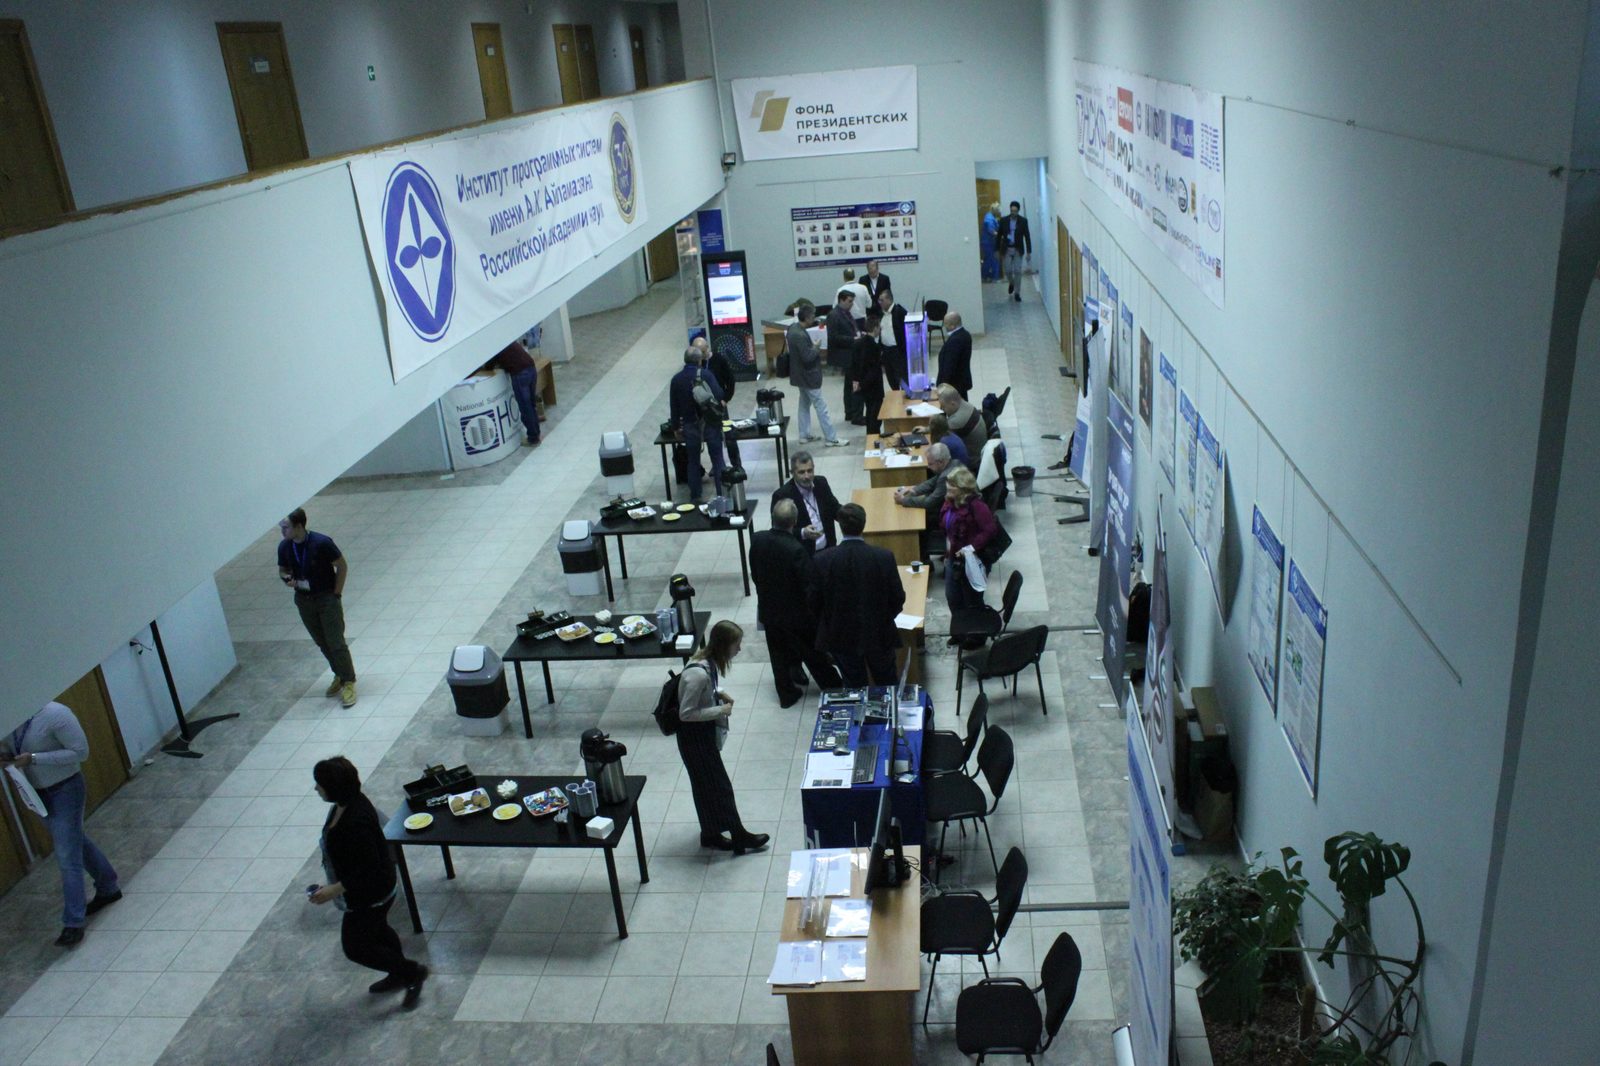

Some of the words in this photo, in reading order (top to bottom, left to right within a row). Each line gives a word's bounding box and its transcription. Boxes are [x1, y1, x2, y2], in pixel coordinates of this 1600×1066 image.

[795, 103, 835, 116] ФОНД
[796, 112, 908, 130] ПРЕЗИДЕНТСКИХ
[797, 131, 857, 144] ГРАНТОВ
[456, 166, 509, 203] Институт
[488, 203, 525, 236] имени
[480, 225, 549, 281] Российской
[456, 399, 485, 413] National
